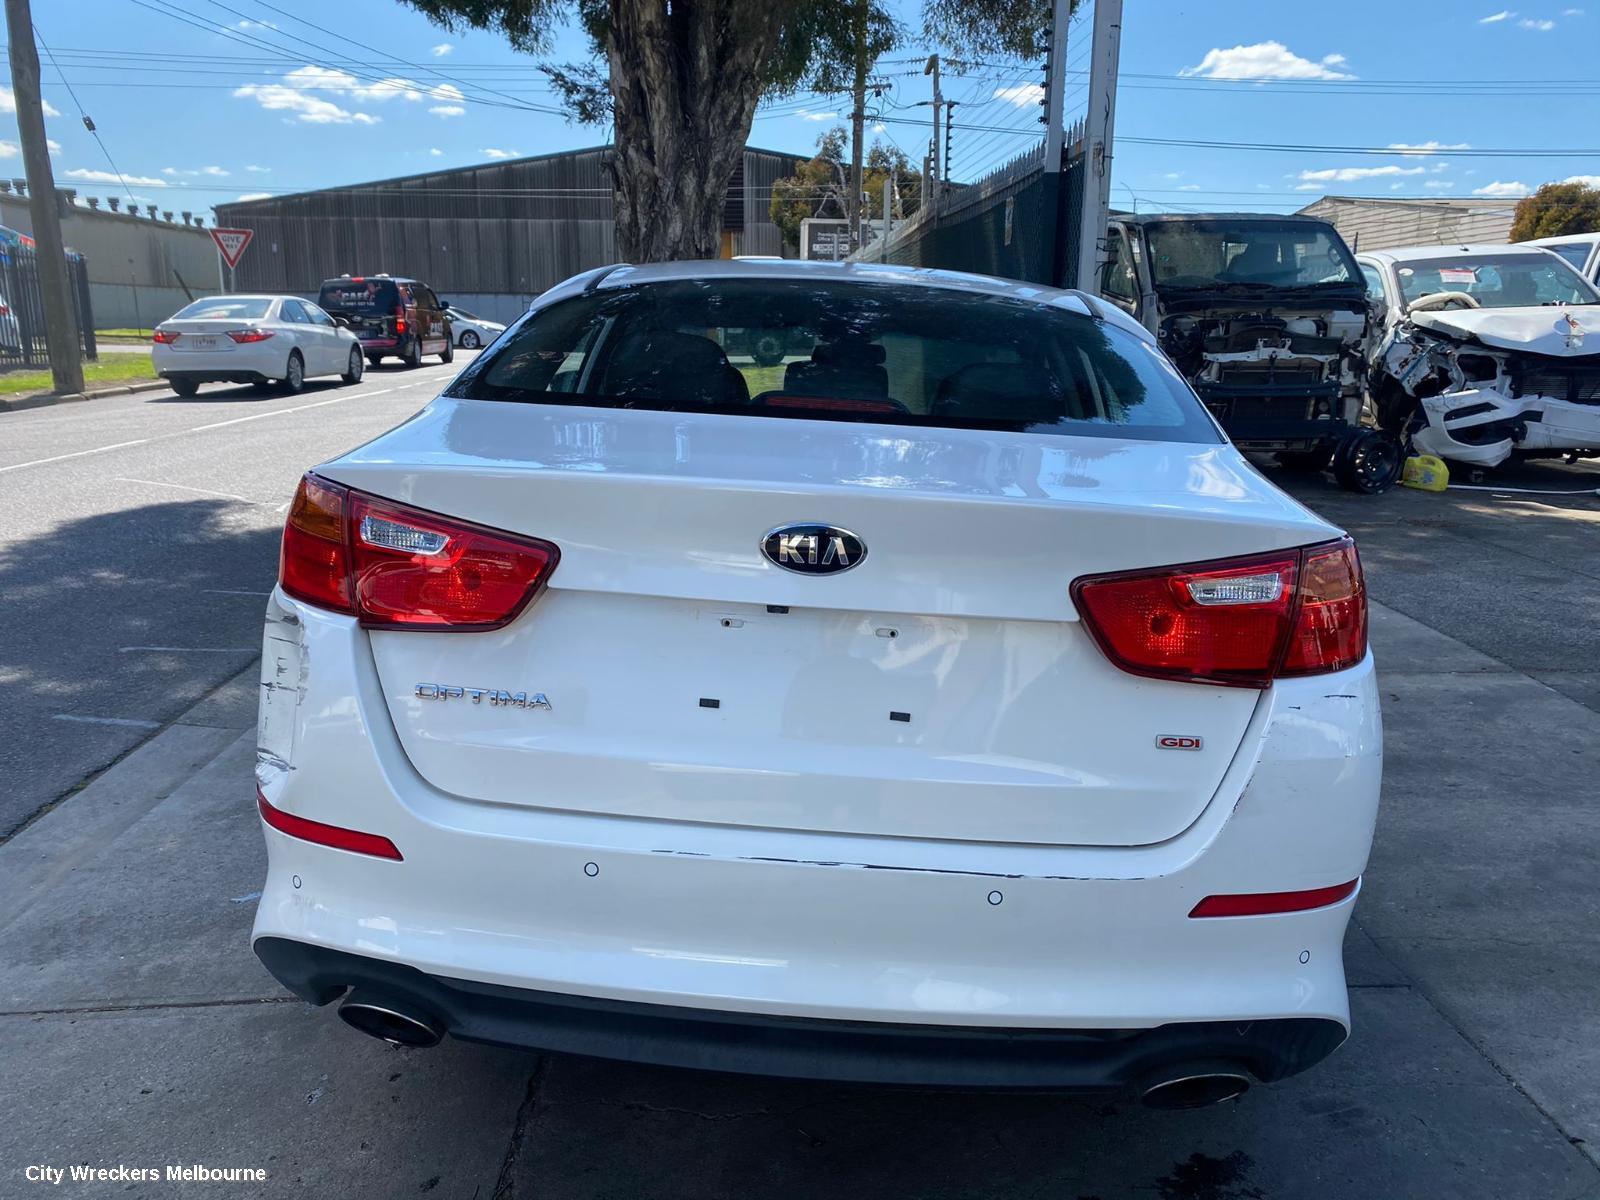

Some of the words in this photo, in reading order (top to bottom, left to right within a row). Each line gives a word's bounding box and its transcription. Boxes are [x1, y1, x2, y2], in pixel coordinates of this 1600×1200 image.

[221, 235, 241, 243] GIVE
[778, 533, 850, 565] KIA
[414, 682, 553, 711] OPTIMA
[1159, 737, 1201, 749] GDI
